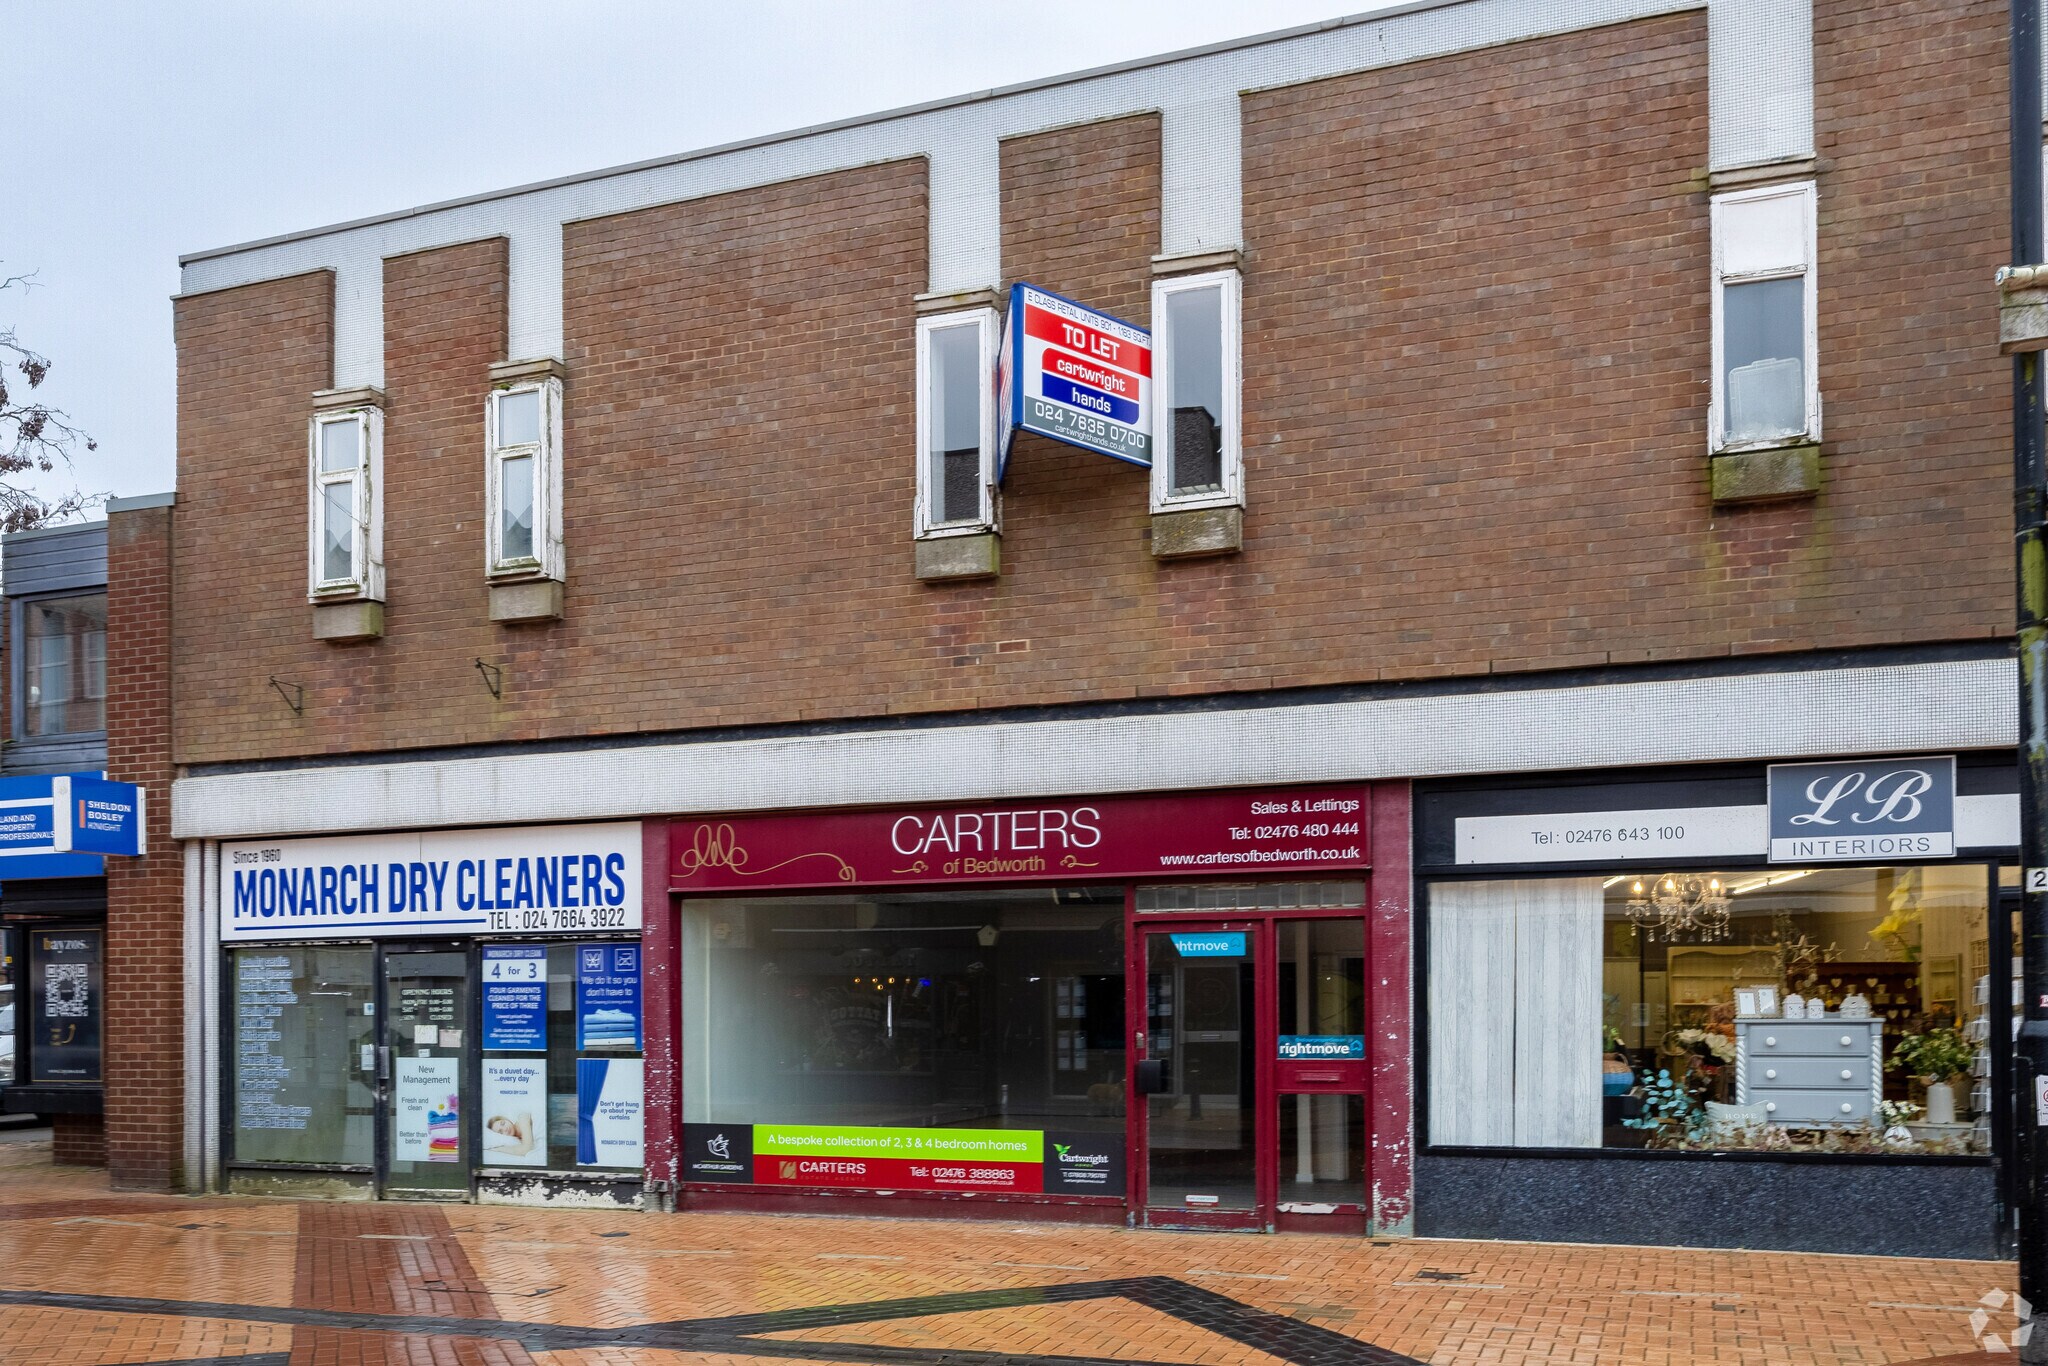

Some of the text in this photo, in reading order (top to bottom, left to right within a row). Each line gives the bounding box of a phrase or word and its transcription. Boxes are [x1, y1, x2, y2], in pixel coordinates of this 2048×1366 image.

[1028, 291, 1033, 302] E
[1034, 294, 1056, 311] CLASS
[1057, 302, 1079, 319] RETAIL
[1080, 311, 1099, 327] UNITS
[1100, 319, 1112, 331] 901
[1062, 323, 1120, 361] TO LET
[1057, 358, 1126, 393] cartwright
[1072, 386, 1111, 413] hands
[1035, 402, 1145, 449] 024 7635 0700
[1055, 424, 1127, 452] cartwrighthands.co.uk
[88, 801, 131, 812] SHELDON
[1250, 799, 1360, 815] Sales & Lettings
[20, 813, 37, 822] AND
[88, 811, 124, 822] BOSLEY
[891, 807, 1101, 855] CARTERS
[1228, 822, 1360, 841] Tel: 02476 480 444
[1566, 828, 1612, 844] 02476
[1618, 827, 1650, 842] 643
[1657, 825, 1685, 841] 100
[1792, 836, 1932, 857] INTERIORS
[233, 849, 281, 864] Since 1960
[1160, 846, 1360, 867] www.cartersofbedworth.co.uk
[943, 855, 1046, 875] of Bedworth
[234, 853, 625, 918] MONARCH DRY CLEANERS
[523, 910, 548, 929] 024
[552, 908, 588, 929] 7664
[590, 907, 625, 928] 3922
[491, 963, 537, 978] 4 for 3
[595, 976, 605, 984] do
[606, 976, 611, 984] it
[623, 977, 638, 986] you
[507, 986, 541, 994] GARMENTS
[586, 988, 633, 996] don't have to
[1279, 1043, 1350, 1057] rightmove
[418, 1065, 435, 1074] New
[489, 1067, 498, 1075] It's
[505, 1067, 522, 1075] duvet
[402, 1075, 451, 1086] Management
[767, 1134, 1028, 1151] A bespoke collection of 2, 3 & 4 bedroom homes
[1059, 1153, 1109, 1165] Cartwright
[800, 1161, 866, 1174] CARTERS
[910, 1166, 1015, 1180] Tel: 02476 388863
